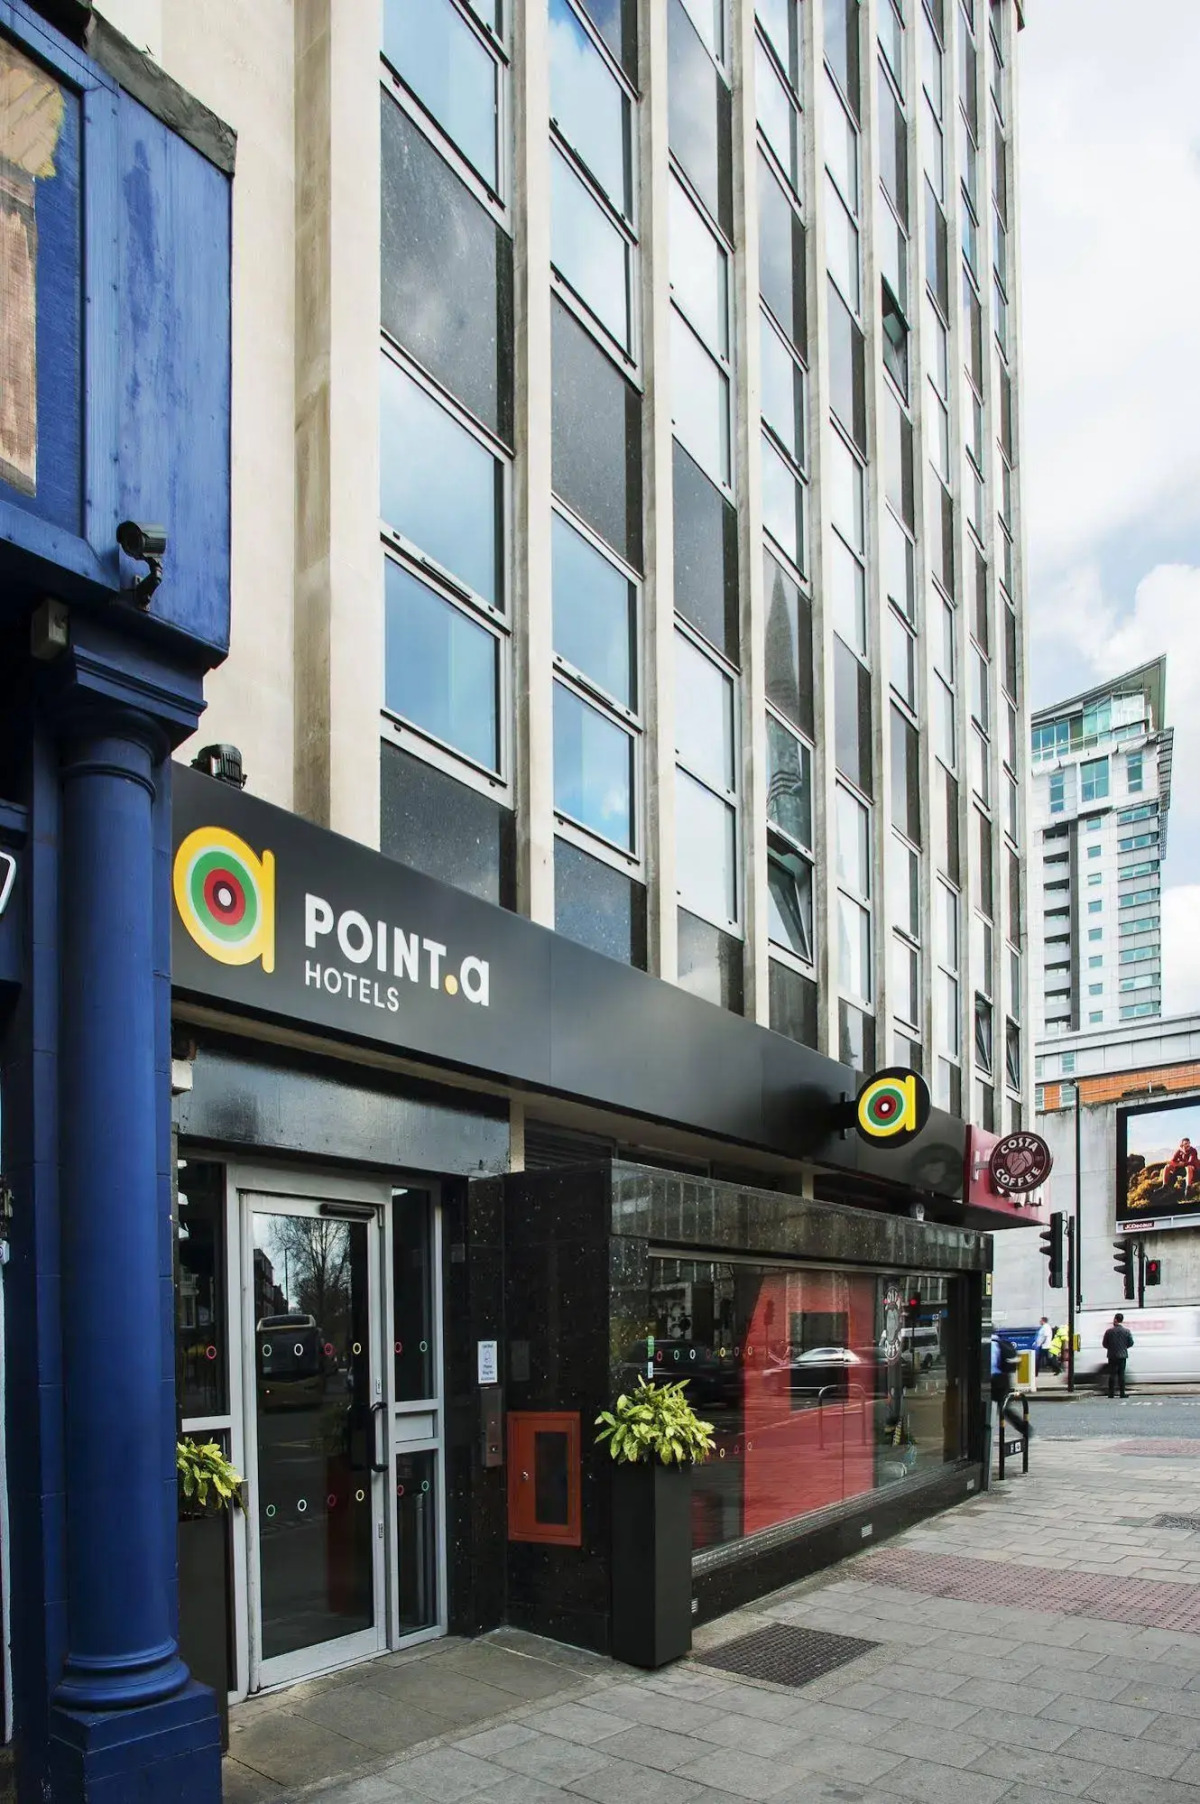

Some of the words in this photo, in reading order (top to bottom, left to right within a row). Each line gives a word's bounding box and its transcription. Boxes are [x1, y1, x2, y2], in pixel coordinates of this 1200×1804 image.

[305, 893, 490, 1007] POINT.a
[305, 960, 400, 1012] HOTELS
[1000, 1137, 1039, 1155] COSTA
[995, 1166, 1041, 1187] COFFEE
